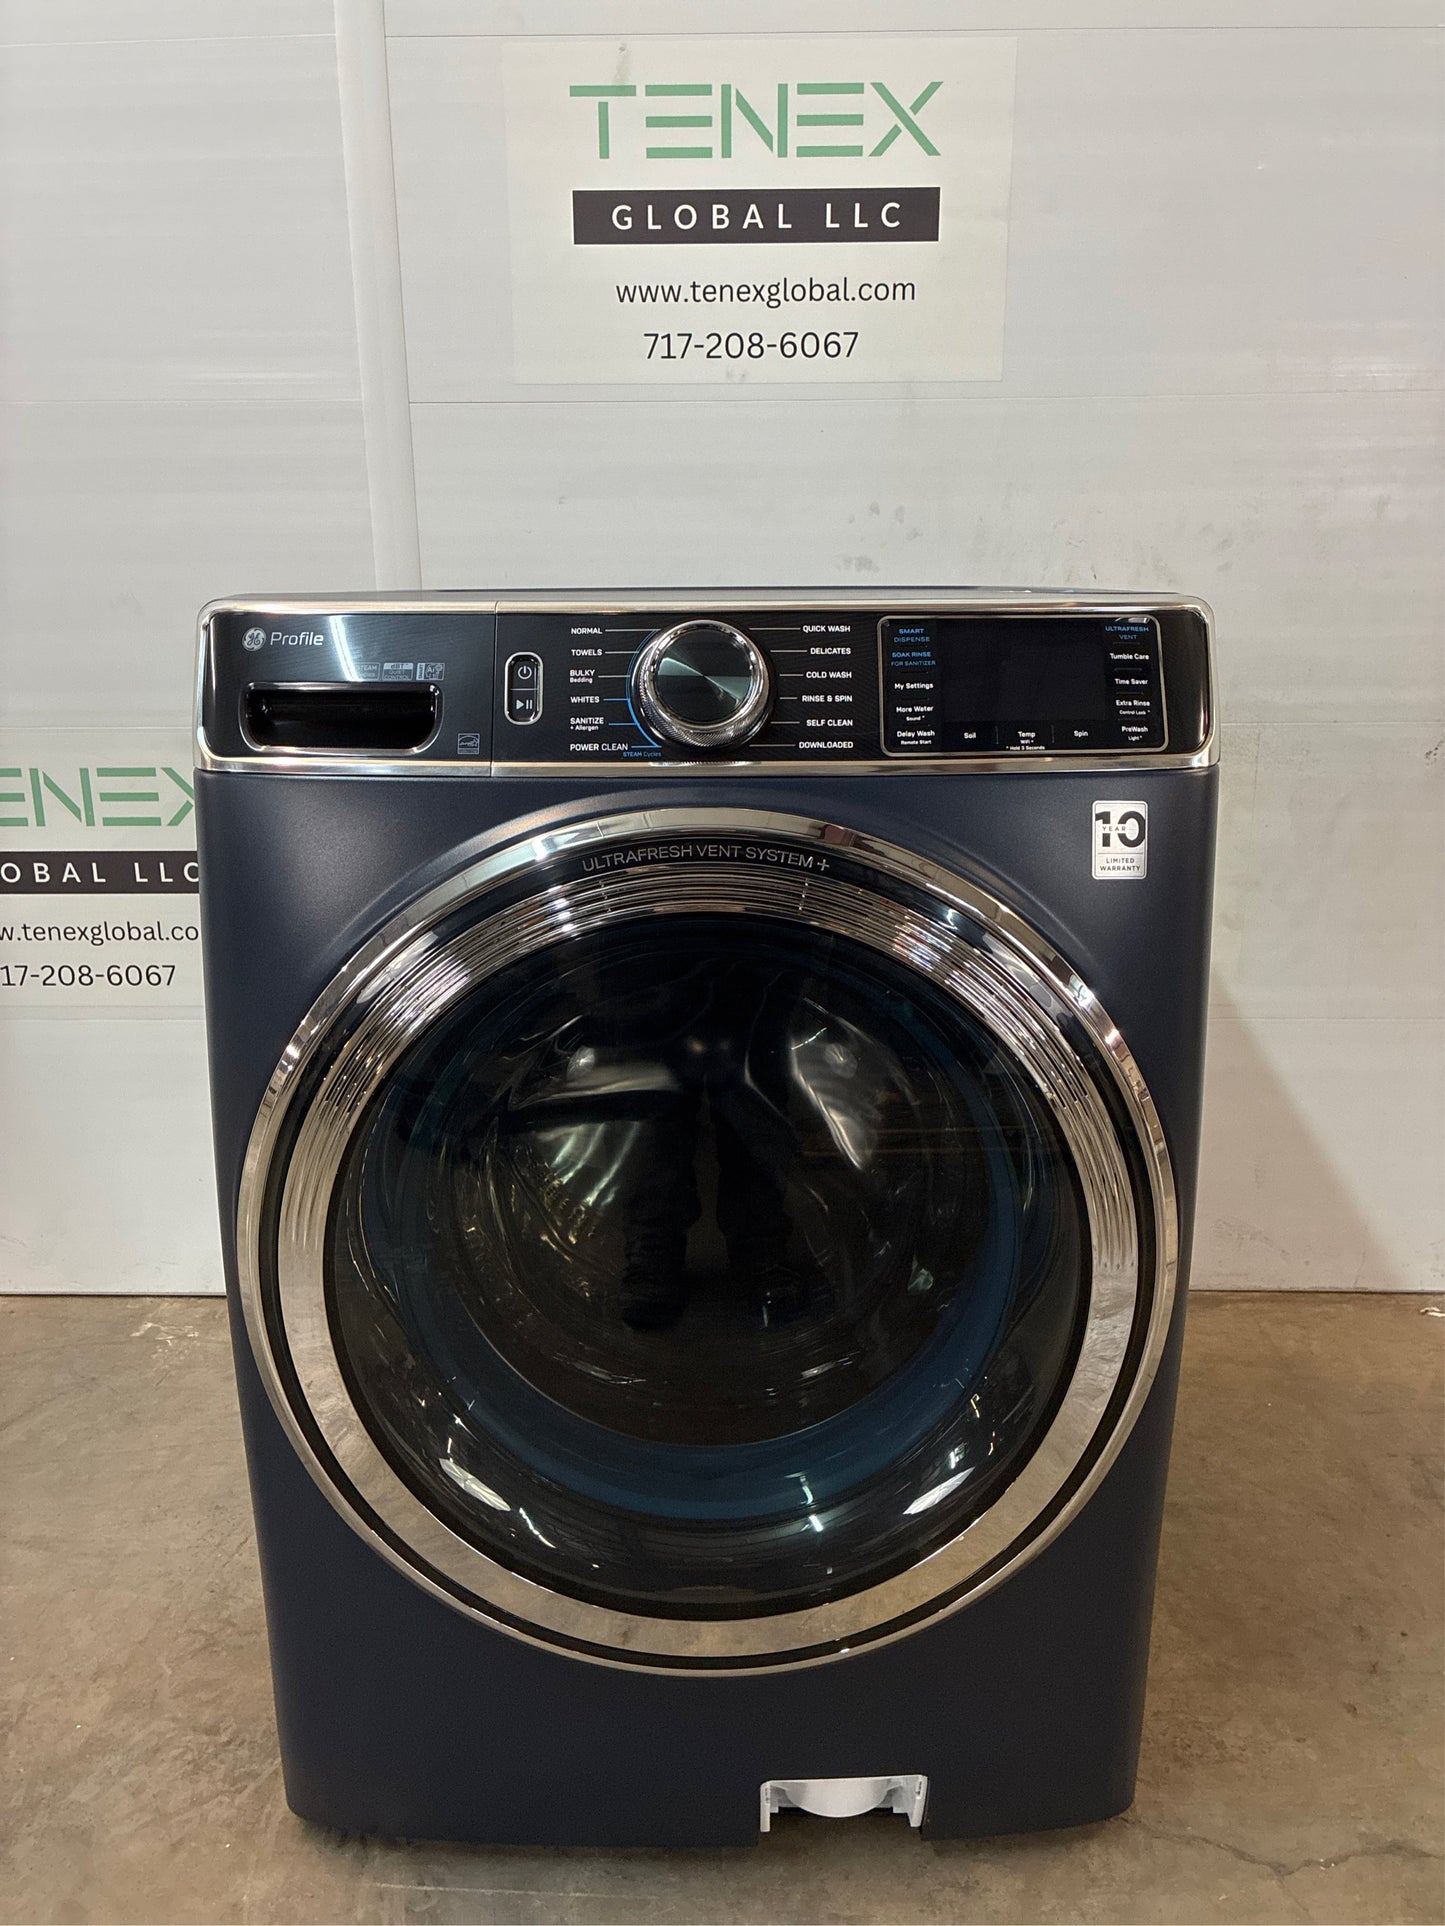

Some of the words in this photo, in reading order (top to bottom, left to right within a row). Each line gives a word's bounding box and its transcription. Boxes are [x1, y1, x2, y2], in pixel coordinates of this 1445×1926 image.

[569, 80, 944, 160] TENEX
[611, 203, 793, 231] GLOBAL
[824, 201, 902, 228] LLC
[615, 276, 917, 309] www.tenexglobal.com
[643, 330, 860, 360] 717-208-6067
[570, 627, 603, 635] NORMAL
[802, 625, 826, 633] QUICK
[828, 625, 851, 633] WASH
[270, 631, 324, 646] Profile
[810, 647, 851, 655] DELICATES
[1109, 652, 1133, 660] Tumble
[1133, 652, 1150, 660] Care
[569, 669, 595, 677] BULKY
[806, 671, 827, 679] COLD
[828, 671, 852, 679] WASH
[894, 682, 904, 690] My
[905, 682, 934, 690] Settings
[802, 695, 825, 703] RINSE
[826, 695, 833, 703] &
[834, 694, 853, 703] SPIN
[1132, 699, 1151, 707] Rinse
[570, 717, 604, 725] SANITIZE
[806, 719, 826, 727] SELF
[827, 718, 853, 727] CLEAN
[1121, 725, 1149, 733] PreWash
[896, 730, 916, 738] Delay
[1017, 731, 1036, 739] Temp
[1073, 730, 1089, 738] Spin
[569, 743, 600, 751] POWER
[601, 743, 628, 751] CLEAN
[798, 741, 854, 749] DOWNLOADED
[1095, 810, 1146, 848] 10
[582, 844, 693, 872] ULTRAFRESH
[696, 845, 741, 858] VENT
